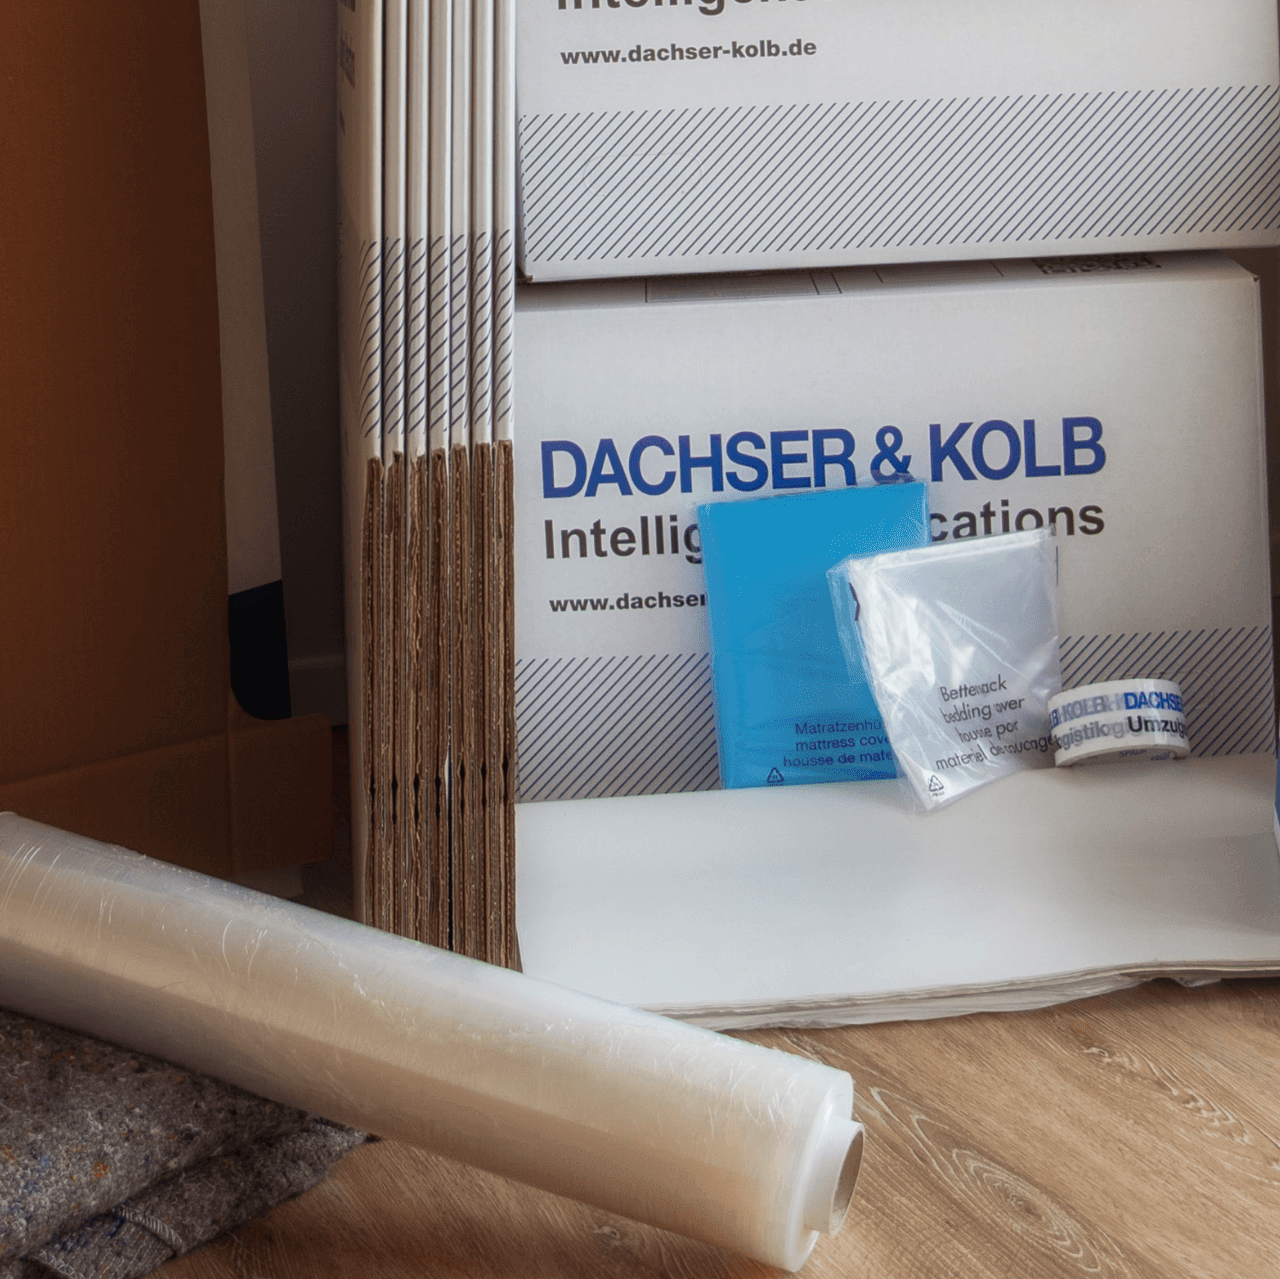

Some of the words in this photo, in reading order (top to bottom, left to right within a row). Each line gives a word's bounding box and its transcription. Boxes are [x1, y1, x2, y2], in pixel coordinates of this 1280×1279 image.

[560, 38, 818, 66] www.dachser-kolb.de
[540, 427, 858, 499] DACHSER
[870, 425, 916, 485] &
[929, 416, 1107, 483] KOLB
[545, 513, 703, 564] Intellig
[929, 499, 1105, 543] cations
[795, 736, 855, 751] mattress
[783, 755, 834, 767] housse
[838, 753, 855, 764] de
